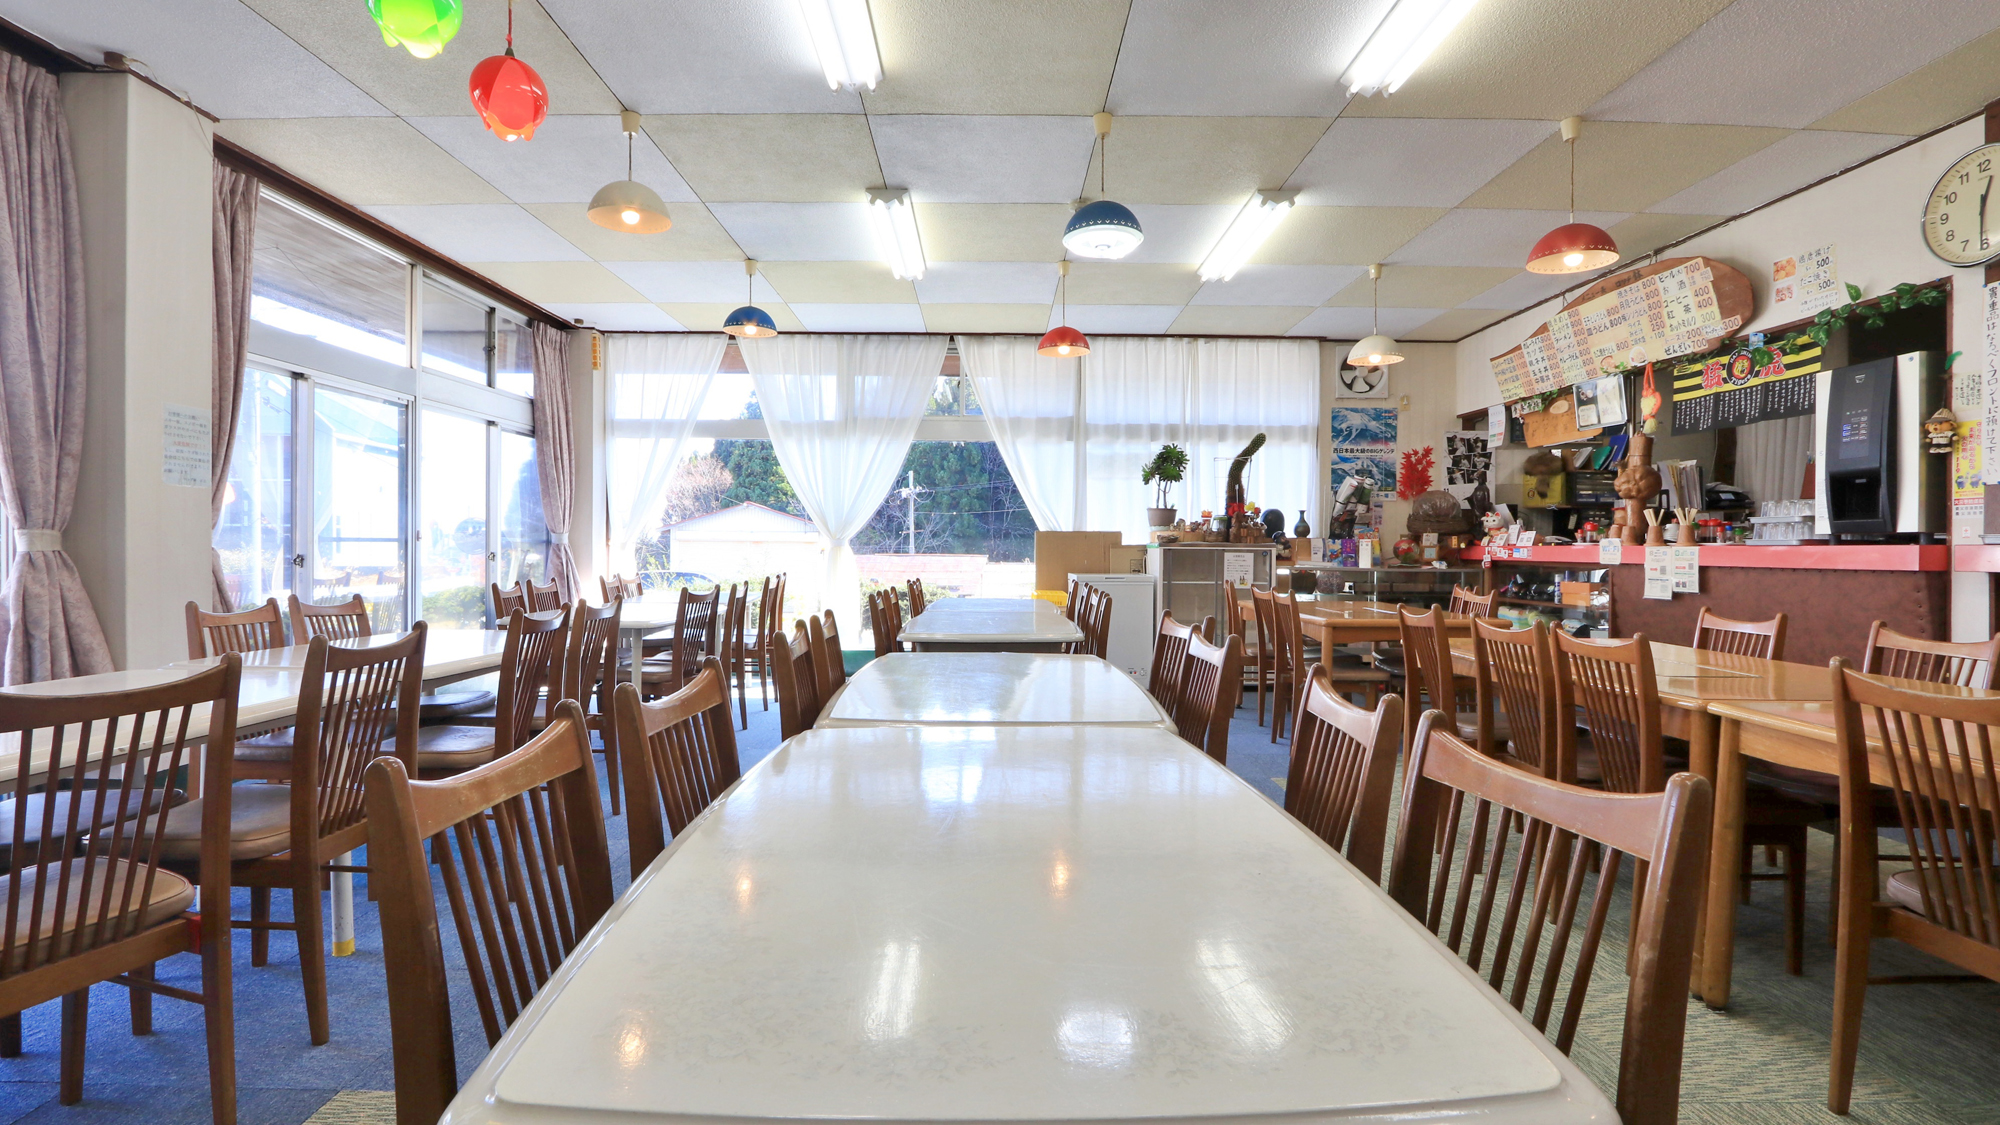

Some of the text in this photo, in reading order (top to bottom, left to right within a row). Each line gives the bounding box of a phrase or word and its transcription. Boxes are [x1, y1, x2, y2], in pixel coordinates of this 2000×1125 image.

[1977, 160, 1991, 173] 12
[1959, 172, 1969, 185] 11
[1944, 192, 1957, 205] 10
[1940, 214, 1949, 225] 9
[1946, 230, 1954, 242] 8
[1961, 240, 1969, 252] 7
[1981, 238, 1989, 250] 6
[1684, 262, 1700, 275] 700
[1642, 277, 1656, 289] 800
[1800, 270, 1828, 286] たこ焼き
[1620, 289, 1659, 310] 月見うどん 800
[1663, 286, 1709, 308] コーヒー 400
[1697, 297, 1713, 309] 400
[1606, 306, 1619, 316] 800
[1648, 300, 1662, 311] 800
[1648, 311, 1662, 322] 300
[1670, 316, 1696, 332] ホットミルク
[1700, 311, 1716, 323] 300
[1571, 319, 1582, 329] 900
[1586, 317, 1621, 336] 皿うどん 800
[1651, 320, 1665, 332] 250
[1722, 318, 1739, 330] 300
[1554, 333, 1571, 344] ラーメン
[1576, 337, 1588, 347] 800
[1665, 333, 1686, 344] トースト
[1686, 328, 1701, 340] 200
[1579, 347, 1590, 357] 800
[1616, 341, 1629, 351] 800
[1665, 338, 1707, 355] ぜんざい 700
[1582, 358, 1594, 367] 800
[1586, 368, 1597, 377] 900
[1702, 360, 1725, 390] 猛
[1731, 374, 1751, 385] Tigers
